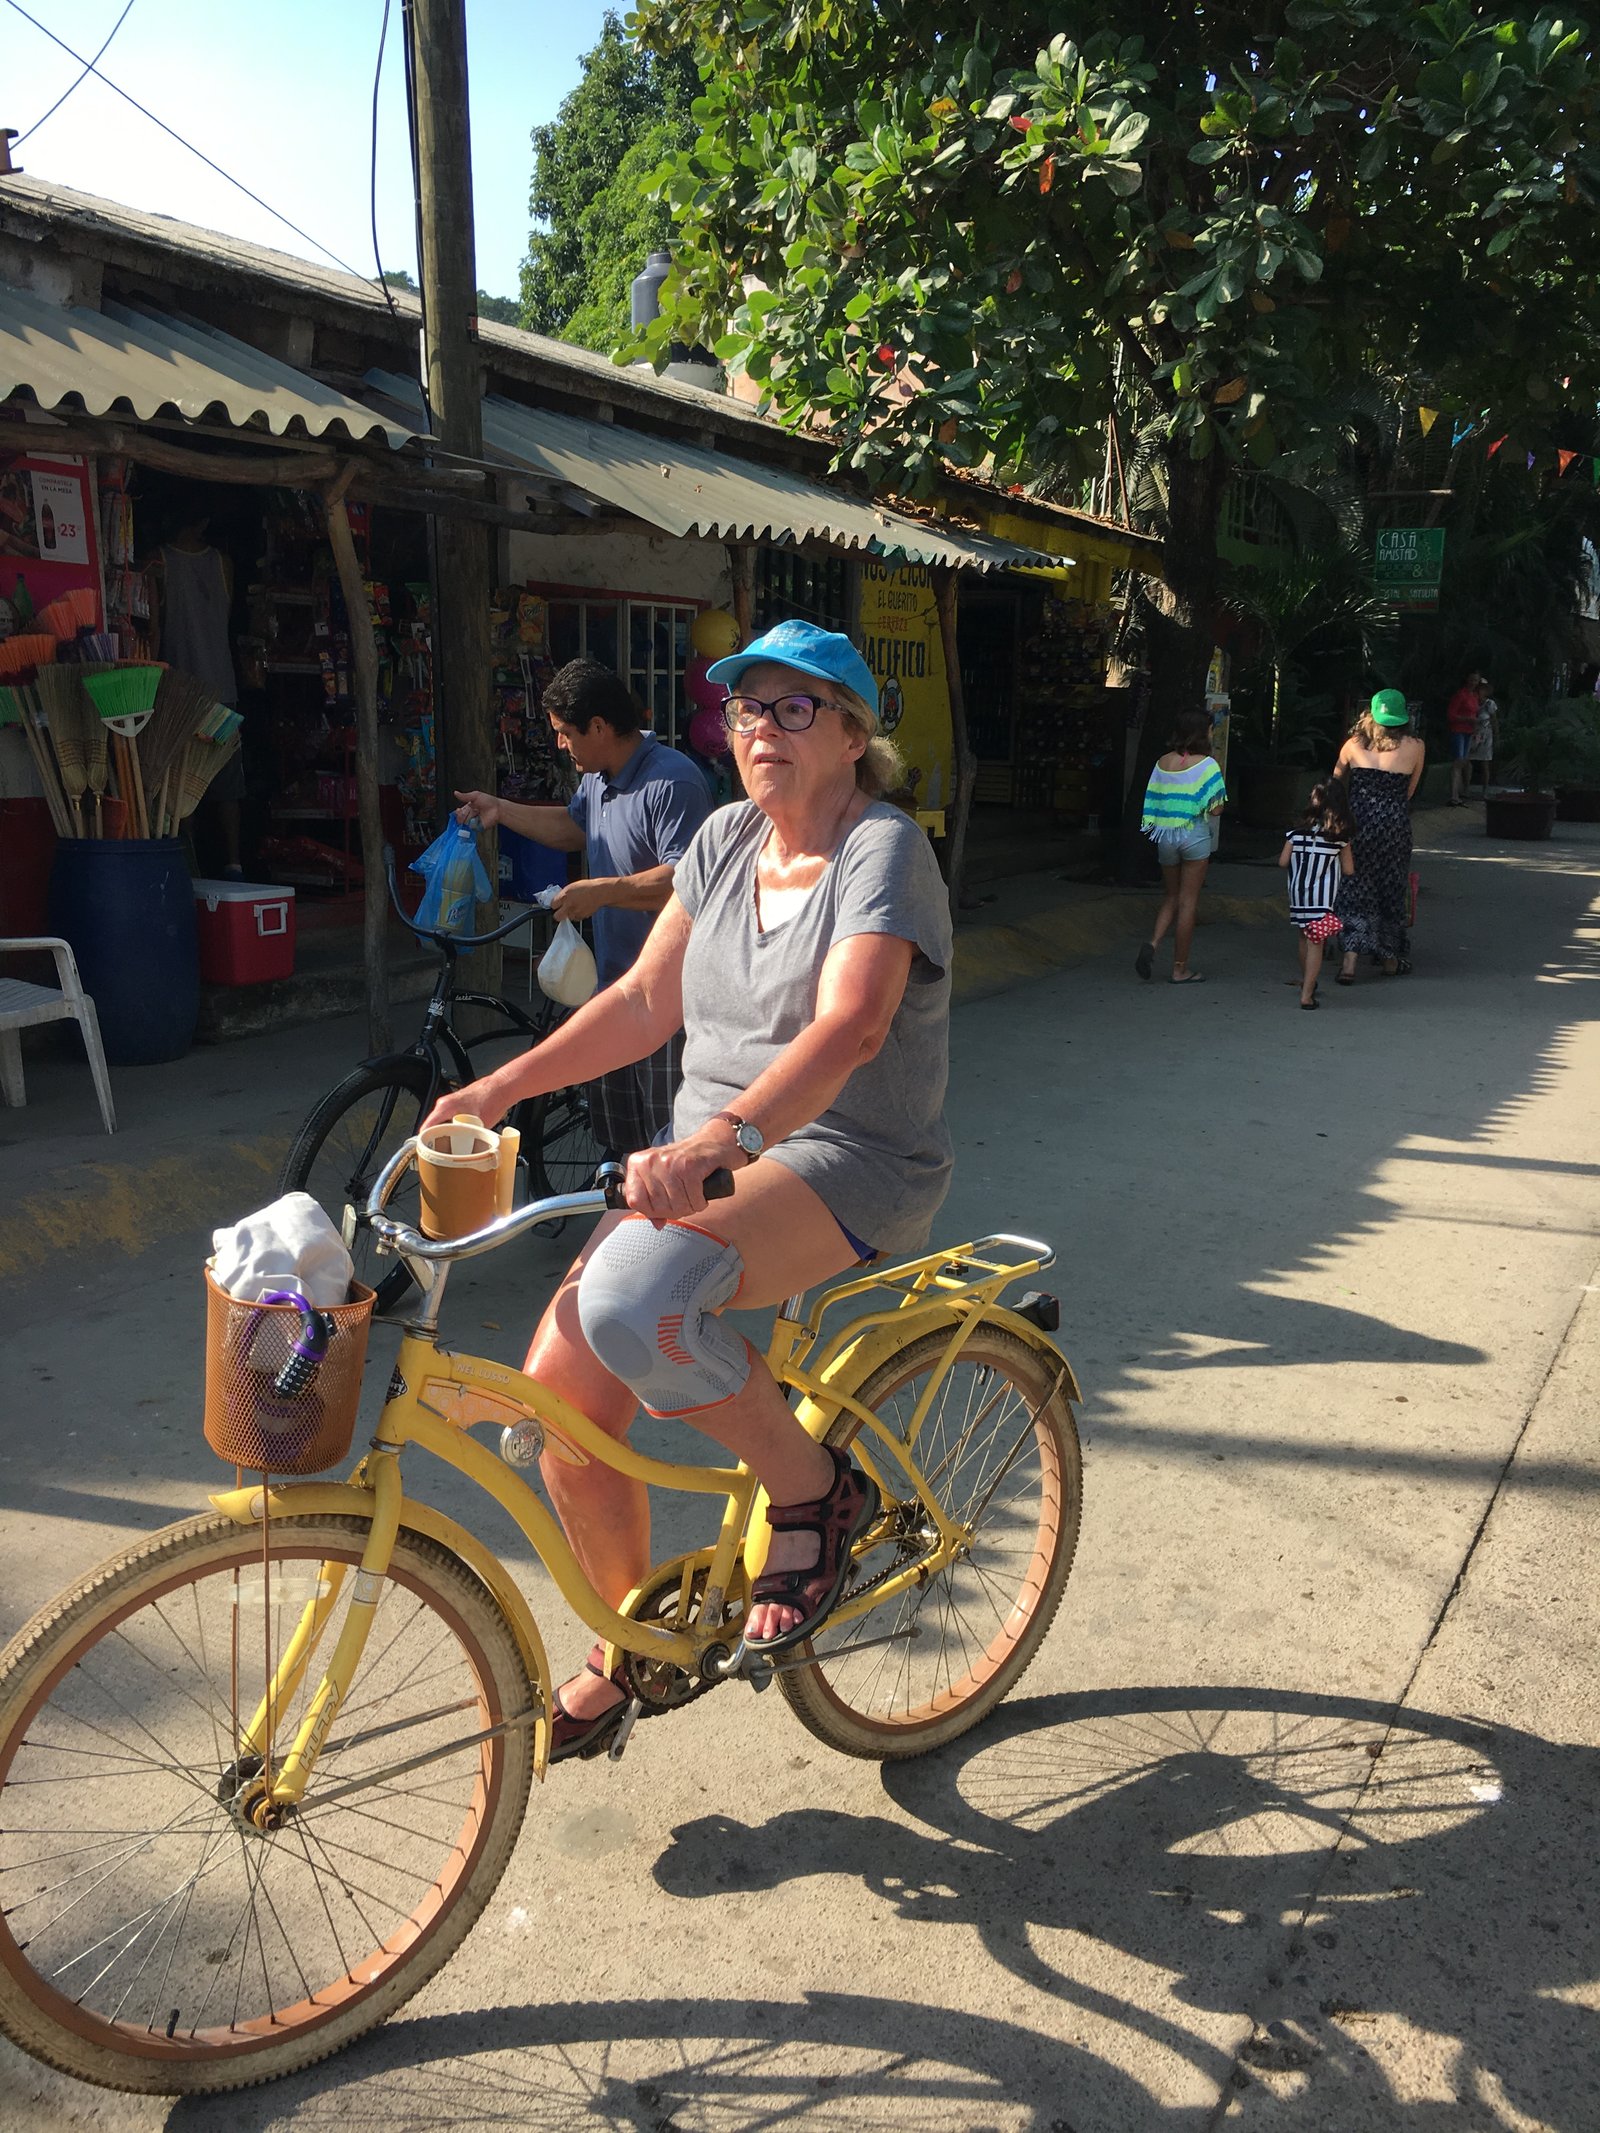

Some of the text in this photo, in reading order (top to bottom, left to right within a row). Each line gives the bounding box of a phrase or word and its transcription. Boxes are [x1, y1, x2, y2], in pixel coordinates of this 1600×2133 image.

[58, 487, 72, 495] MESA
[1380, 532, 1416, 548] CASA
[1380, 549, 1417, 561] AMISTAD
[877, 589, 918, 612] EL GUERITO
[456, 1363, 511, 1384] NEL LUSSO
[299, 1680, 341, 1772] HUFFY
